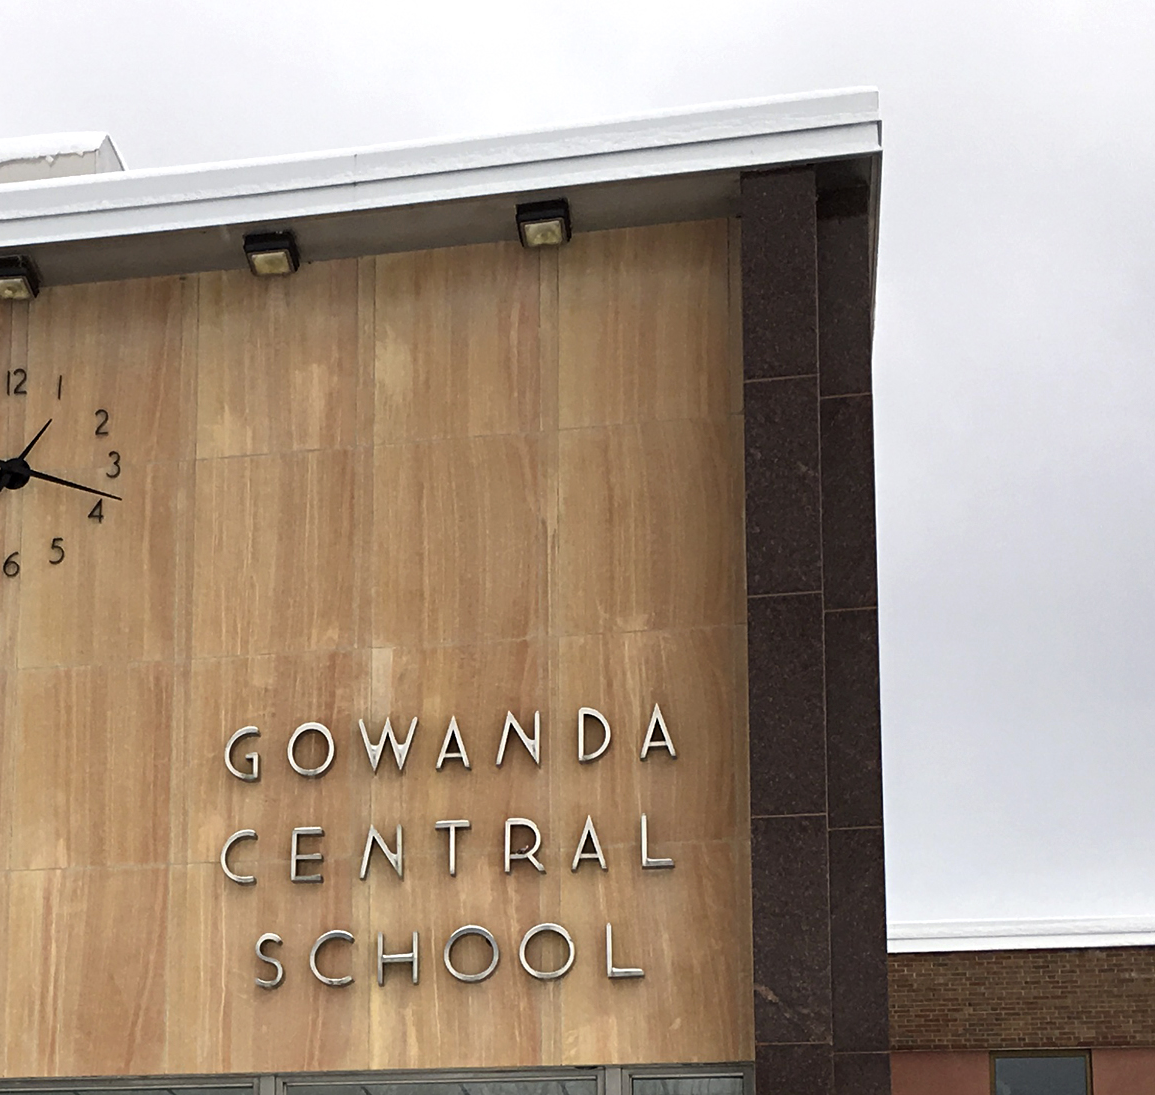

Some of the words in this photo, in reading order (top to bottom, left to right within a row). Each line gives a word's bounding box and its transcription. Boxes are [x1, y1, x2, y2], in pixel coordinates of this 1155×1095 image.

[6, 368, 28, 396] 12
[57, 374, 63, 400] 1
[95, 409, 110, 436] 2
[106, 451, 121, 479] 3
[88, 498, 104, 524] 4
[3, 552, 20, 577] 6
[49, 537, 65, 565] 5
[224, 703, 679, 783] GOWANDA
[219, 814, 676, 885] CENTRAL
[254, 922, 645, 989] SCHOOL
